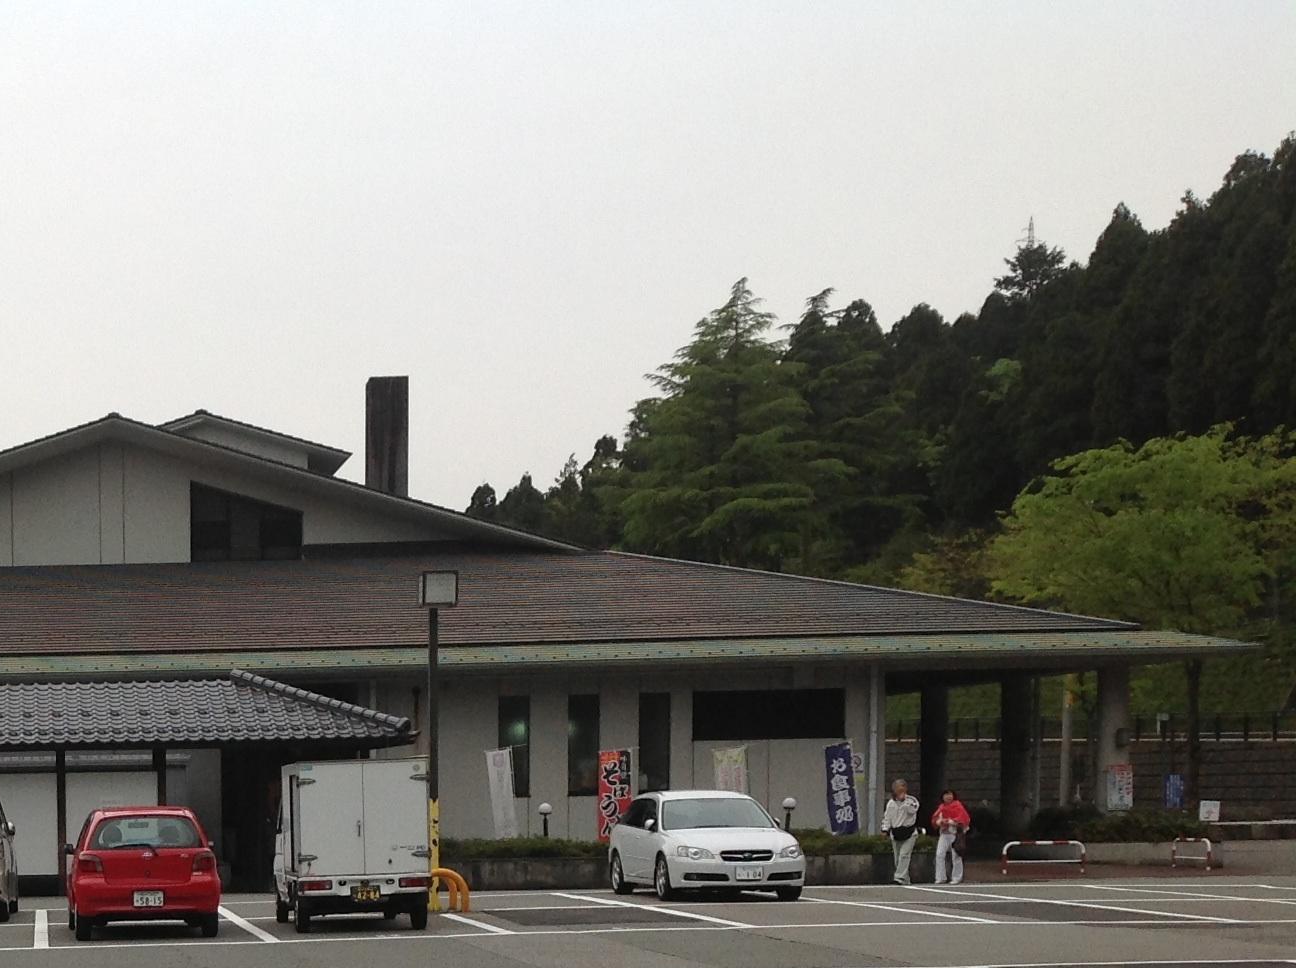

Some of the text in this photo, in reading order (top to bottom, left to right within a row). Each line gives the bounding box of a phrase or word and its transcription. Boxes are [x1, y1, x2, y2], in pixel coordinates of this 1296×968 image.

[600, 760, 629, 837] そばうん
[830, 757, 854, 824] お食事処
